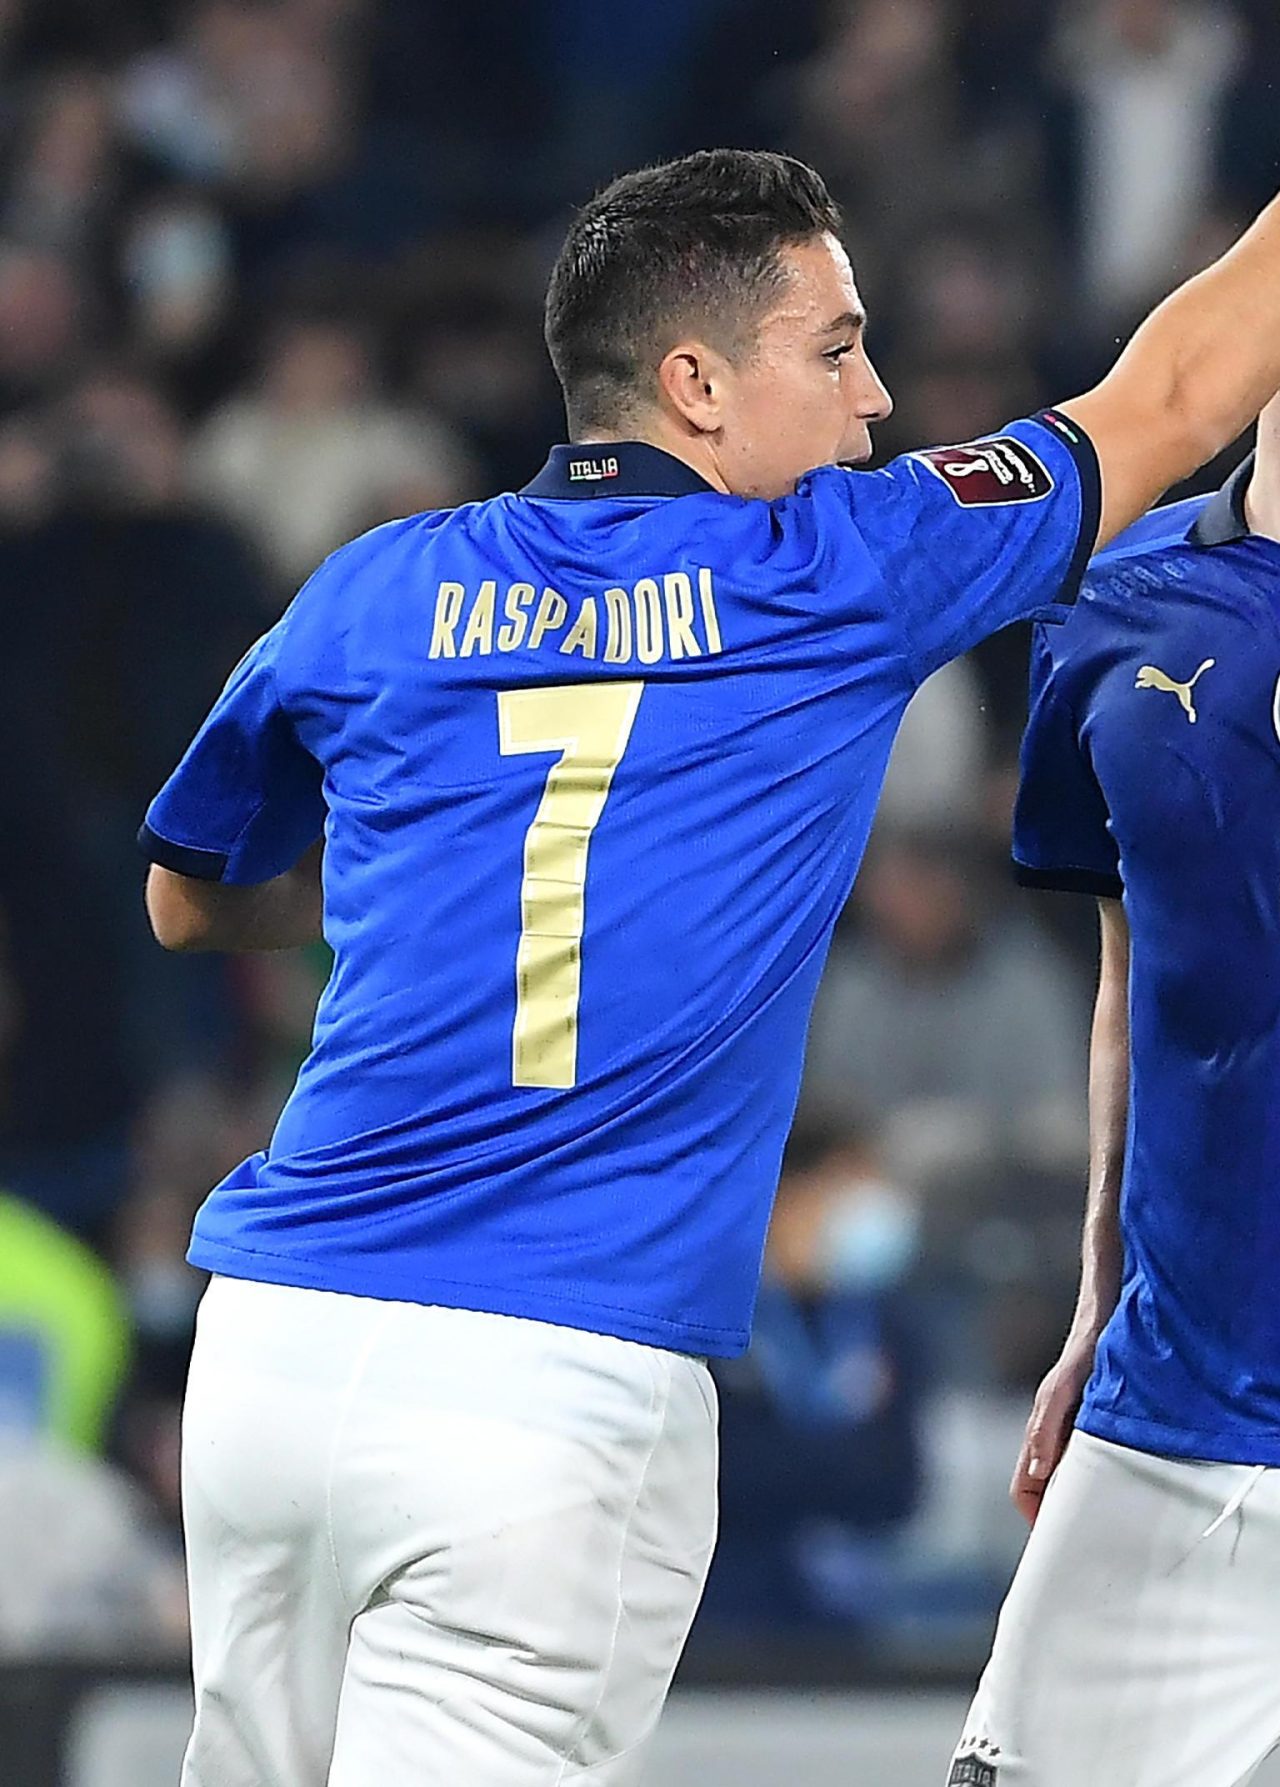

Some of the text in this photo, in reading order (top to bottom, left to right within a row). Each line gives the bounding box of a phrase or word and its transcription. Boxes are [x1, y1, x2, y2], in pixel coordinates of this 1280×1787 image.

[570, 458, 618, 475] ITALIA
[428, 567, 722, 664] RASPADORI
[497, 681, 645, 1089] 7
